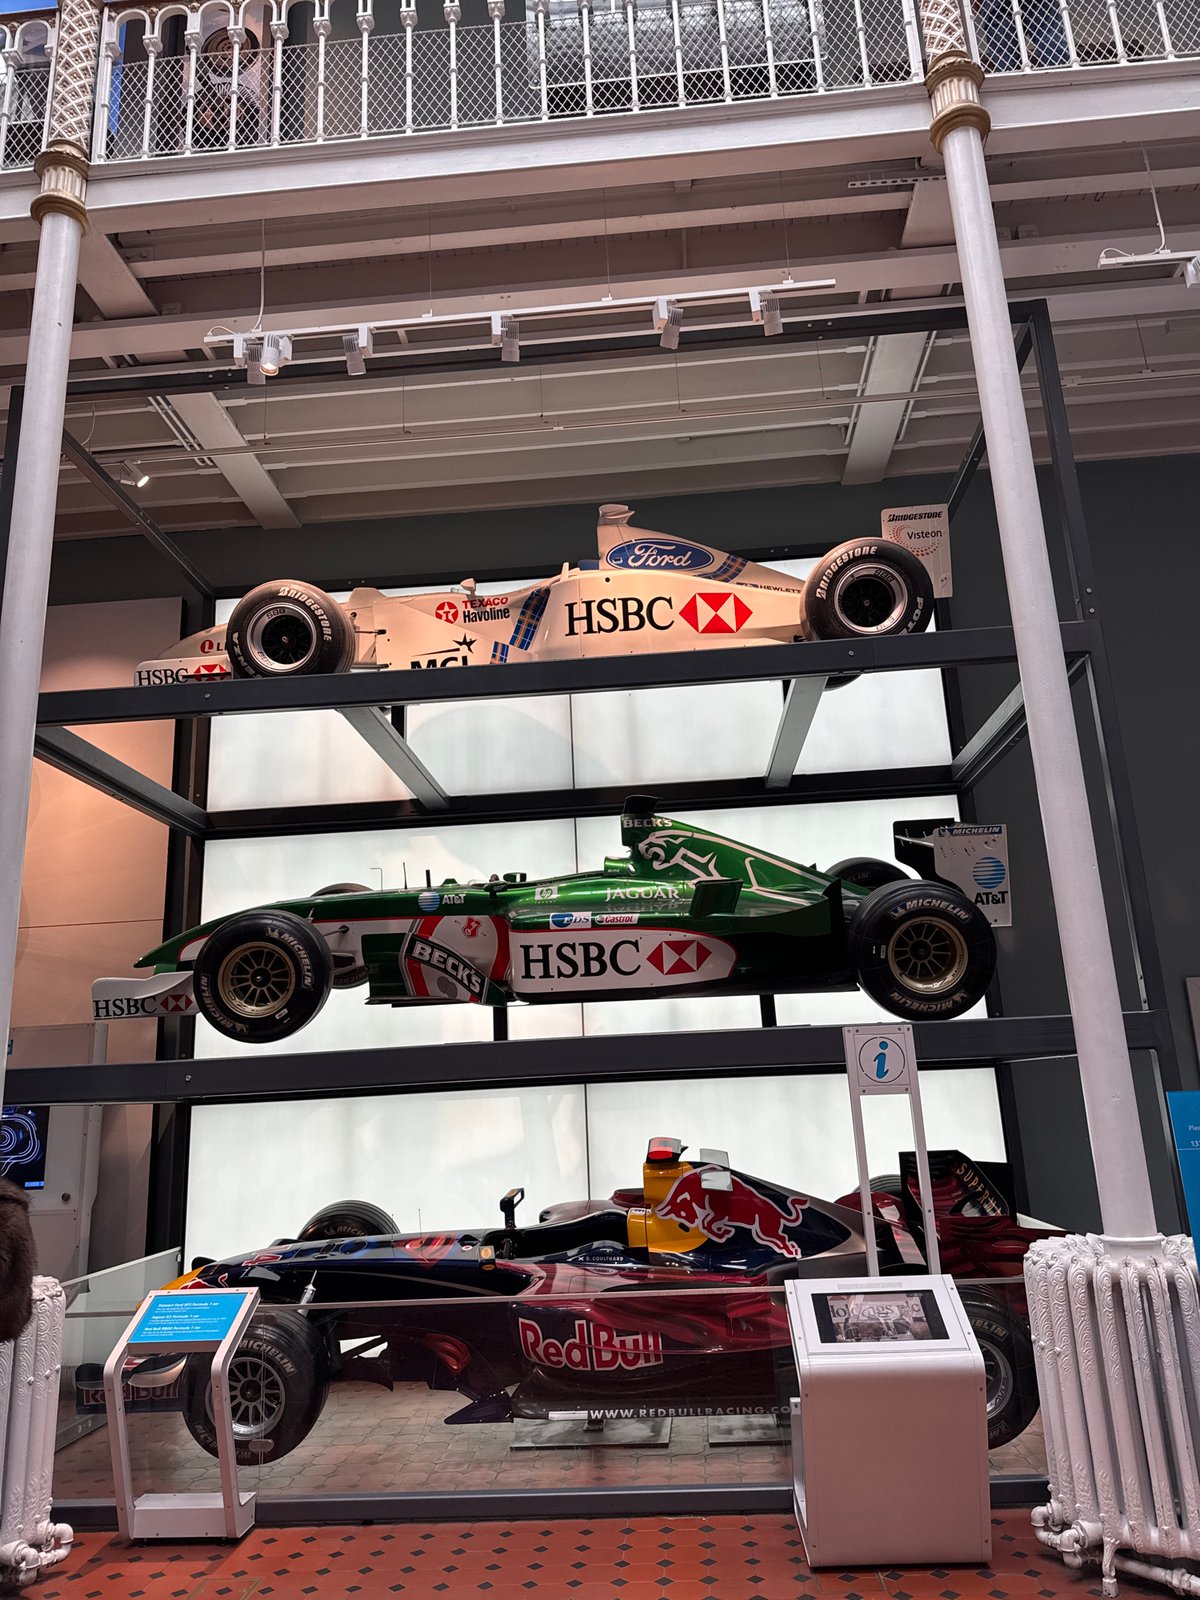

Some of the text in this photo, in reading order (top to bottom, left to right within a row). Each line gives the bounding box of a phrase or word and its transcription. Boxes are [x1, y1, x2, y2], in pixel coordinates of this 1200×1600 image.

[887, 511, 943, 522] BRIDGESTONE
[907, 529, 943, 540] Visteon
[628, 543, 692, 567] Ford
[815, 546, 878, 600] BRIDGESTONE
[760, 584, 801, 594] HEWLETT
[461, 597, 509, 609] TEXACO
[277, 586, 333, 642] BRIDGESTONE
[463, 607, 511, 624] Havoline
[565, 596, 675, 637] HSBC
[136, 667, 189, 686] HSBC
[952, 826, 1000, 834] MICHELIN
[442, 894, 466, 904] AT&T
[605, 888, 680, 902] JAGUAR
[974, 891, 1008, 905] AT&T
[905, 898, 969, 920] MICHELIN
[604, 914, 634, 924] Castrol
[280, 933, 313, 988] MICHELIN
[412, 940, 482, 994] BECK'S
[519, 940, 641, 979] HSBC
[93, 997, 158, 1018] HSBC
[518, 1317, 664, 1371] Red Bull
[590, 1405, 791, 1420] WWW.REDBULLRACING.CO
